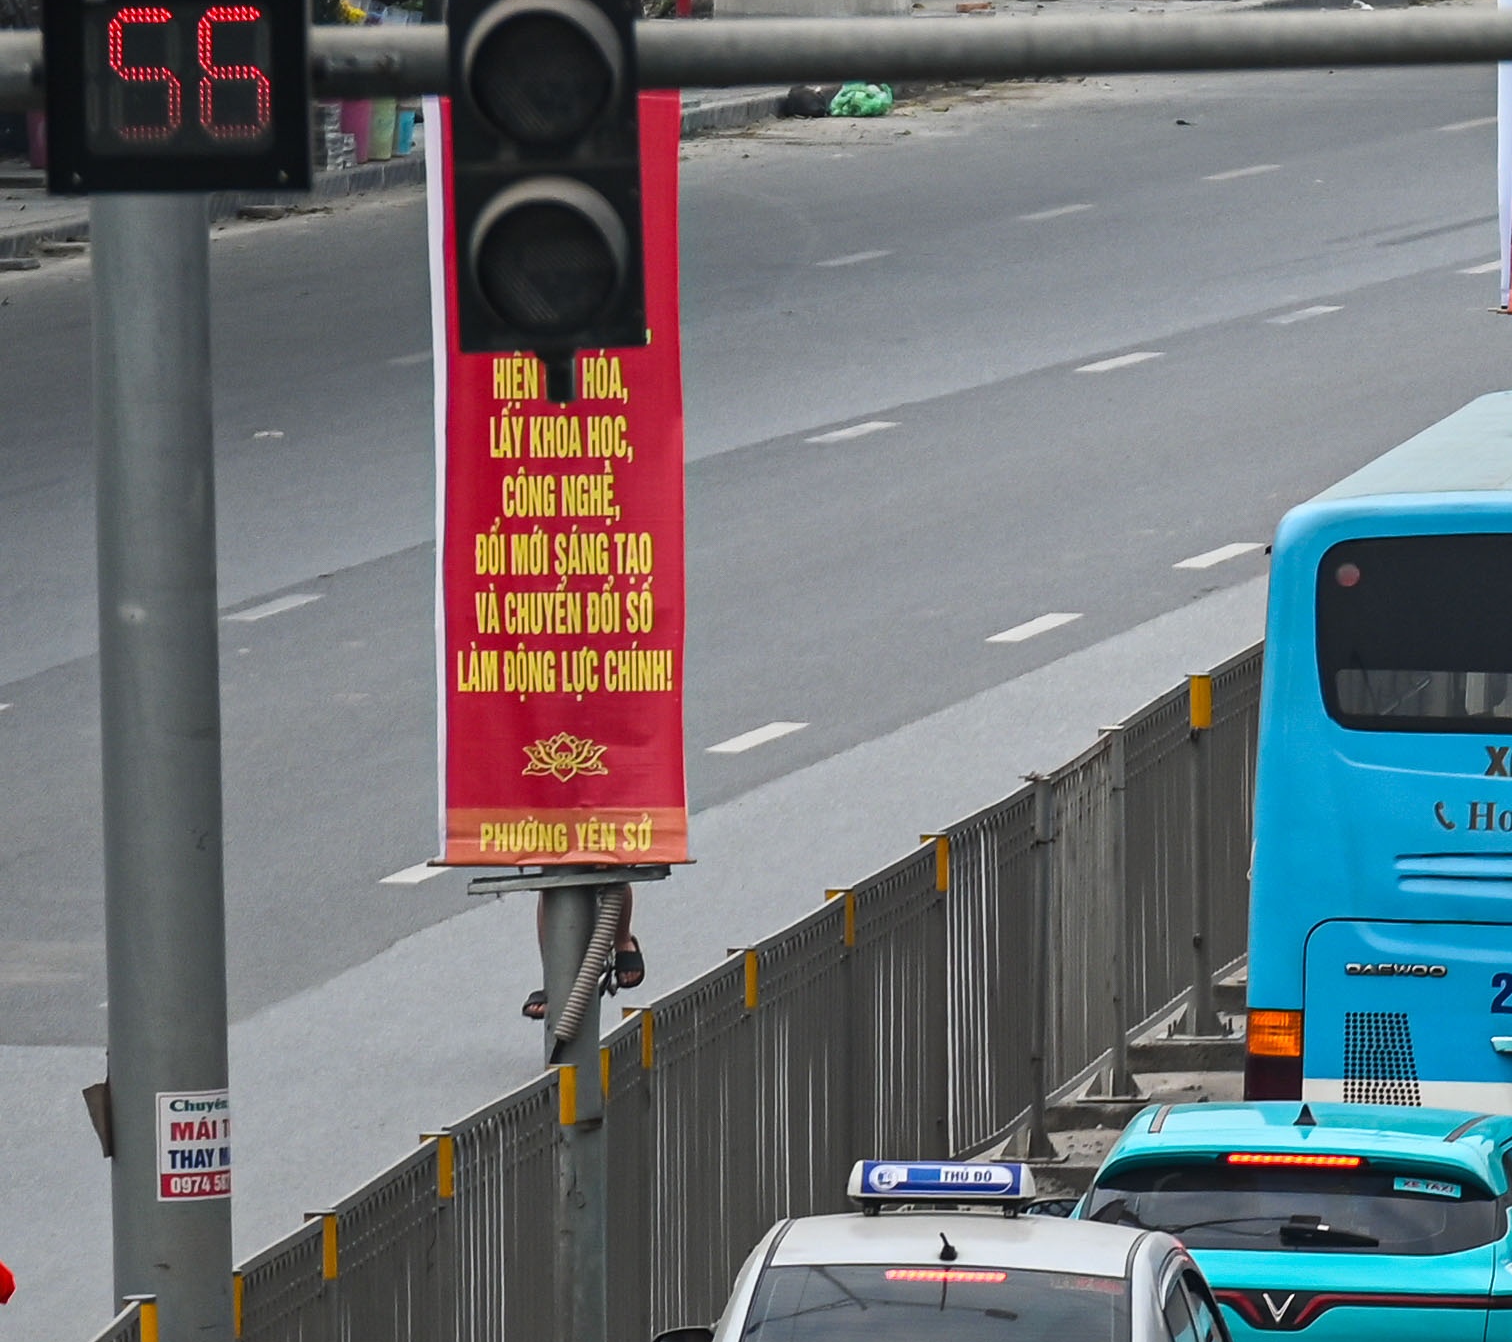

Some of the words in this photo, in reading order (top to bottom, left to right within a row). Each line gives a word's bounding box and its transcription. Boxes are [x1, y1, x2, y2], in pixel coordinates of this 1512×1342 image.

[109, 6, 270, 139] 56
[493, 350, 537, 407] HIỆN
[583, 349, 628, 405] HÓA,
[490, 402, 523, 458] LẤY
[529, 416, 581, 458] KHOA
[587, 416, 633, 468] HỌC,
[502, 468, 555, 518] CÔNG
[562, 466, 620, 525] NGHỆ,
[476, 517, 507, 575] ĐỔI
[512, 525, 548, 575] MỚI
[555, 525, 609, 575] SÁNG
[615, 532, 651, 585] TẠO
[476, 581, 500, 635] VÀ
[504, 577, 581, 634] CHUYỂN
[587, 577, 620, 633] ĐỔI
[626, 577, 653, 632] SỐ
[458, 642, 498, 692] LÀM
[503, 643, 555, 701] ĐỘNG
[561, 646, 598, 701] LỰC
[604, 643, 673, 692] CHÍNH!
[480, 817, 567, 853] PHƯỜNG
[575, 820, 615, 851] YÊN
[623, 813, 651, 851] SỞ
[1345, 964, 1447, 977] DAEWOO
[168, 1149, 216, 1170] THAY
[170, 1118, 218, 1143] MÁI
[943, 1167, 969, 1182] THỦ
[974, 1169, 992, 1182] ĐÔ
